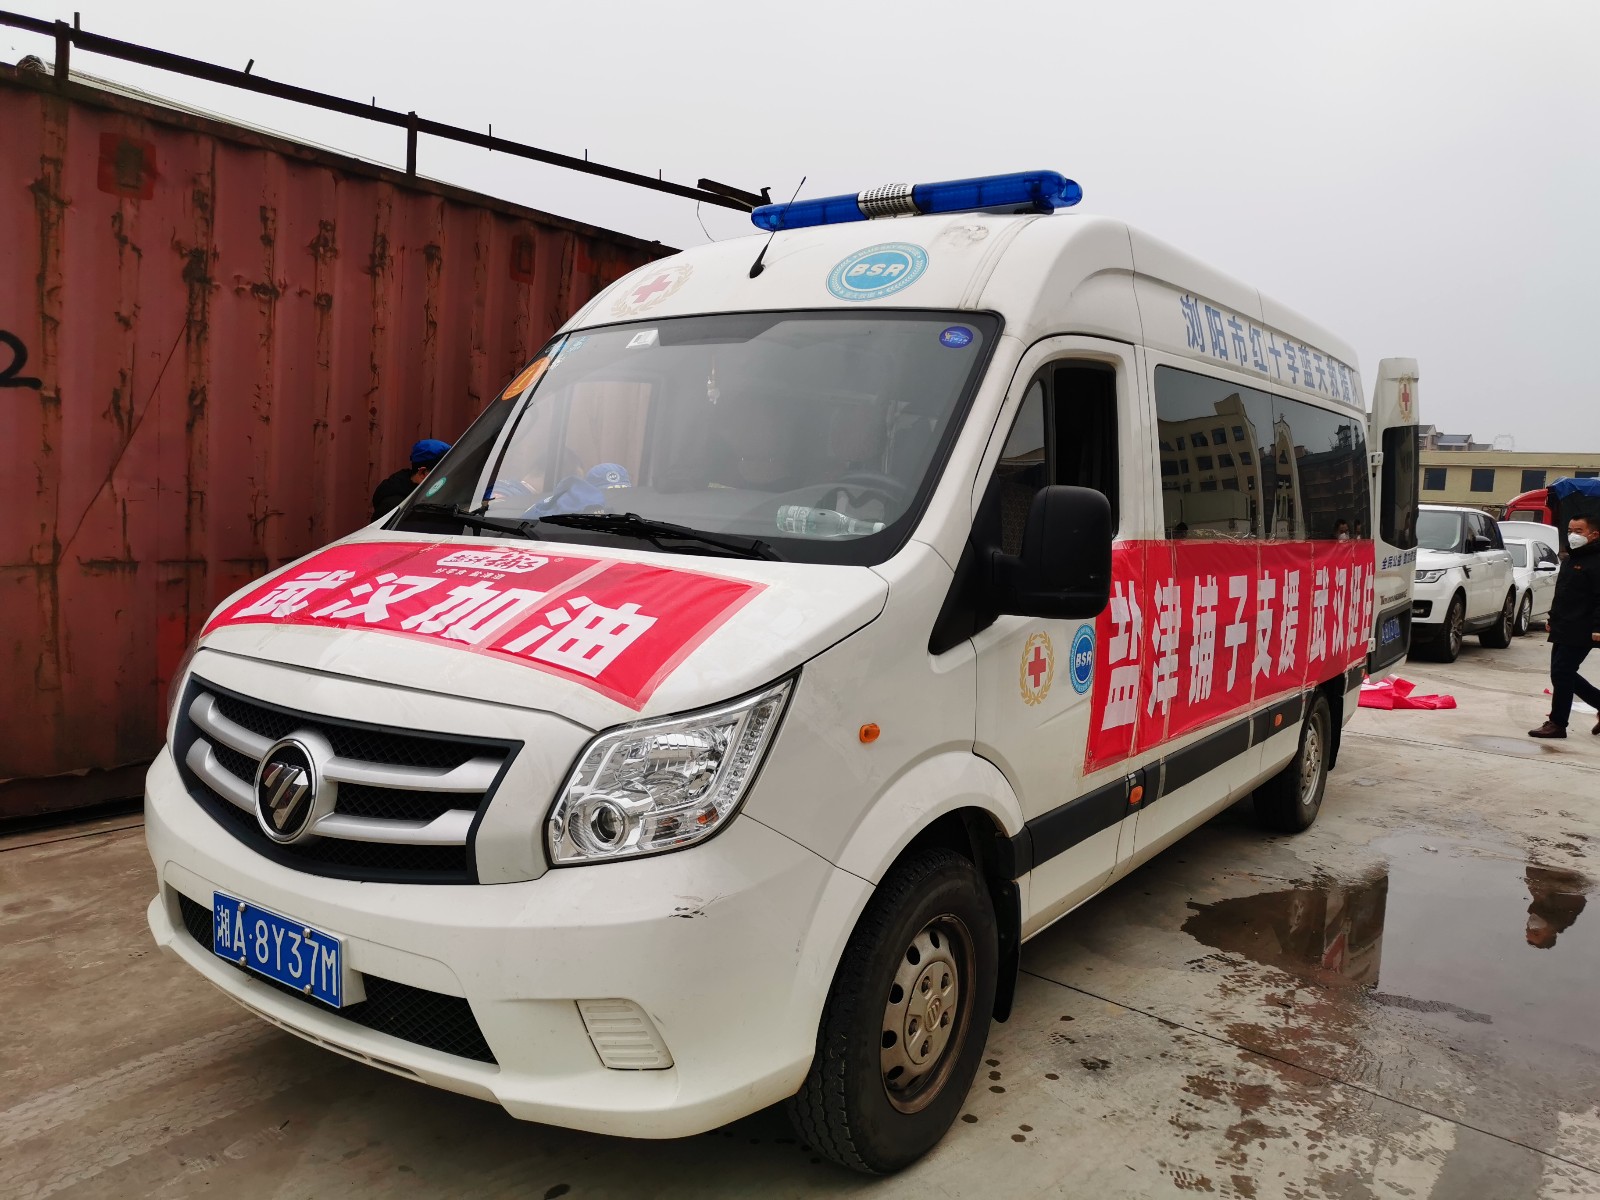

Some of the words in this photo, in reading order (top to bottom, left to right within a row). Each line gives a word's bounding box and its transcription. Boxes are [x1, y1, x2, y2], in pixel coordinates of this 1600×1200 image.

[848, 263, 905, 277] BSR
[231, 568, 659, 679] 武汉加油
[1076, 650, 1092, 668] BSR
